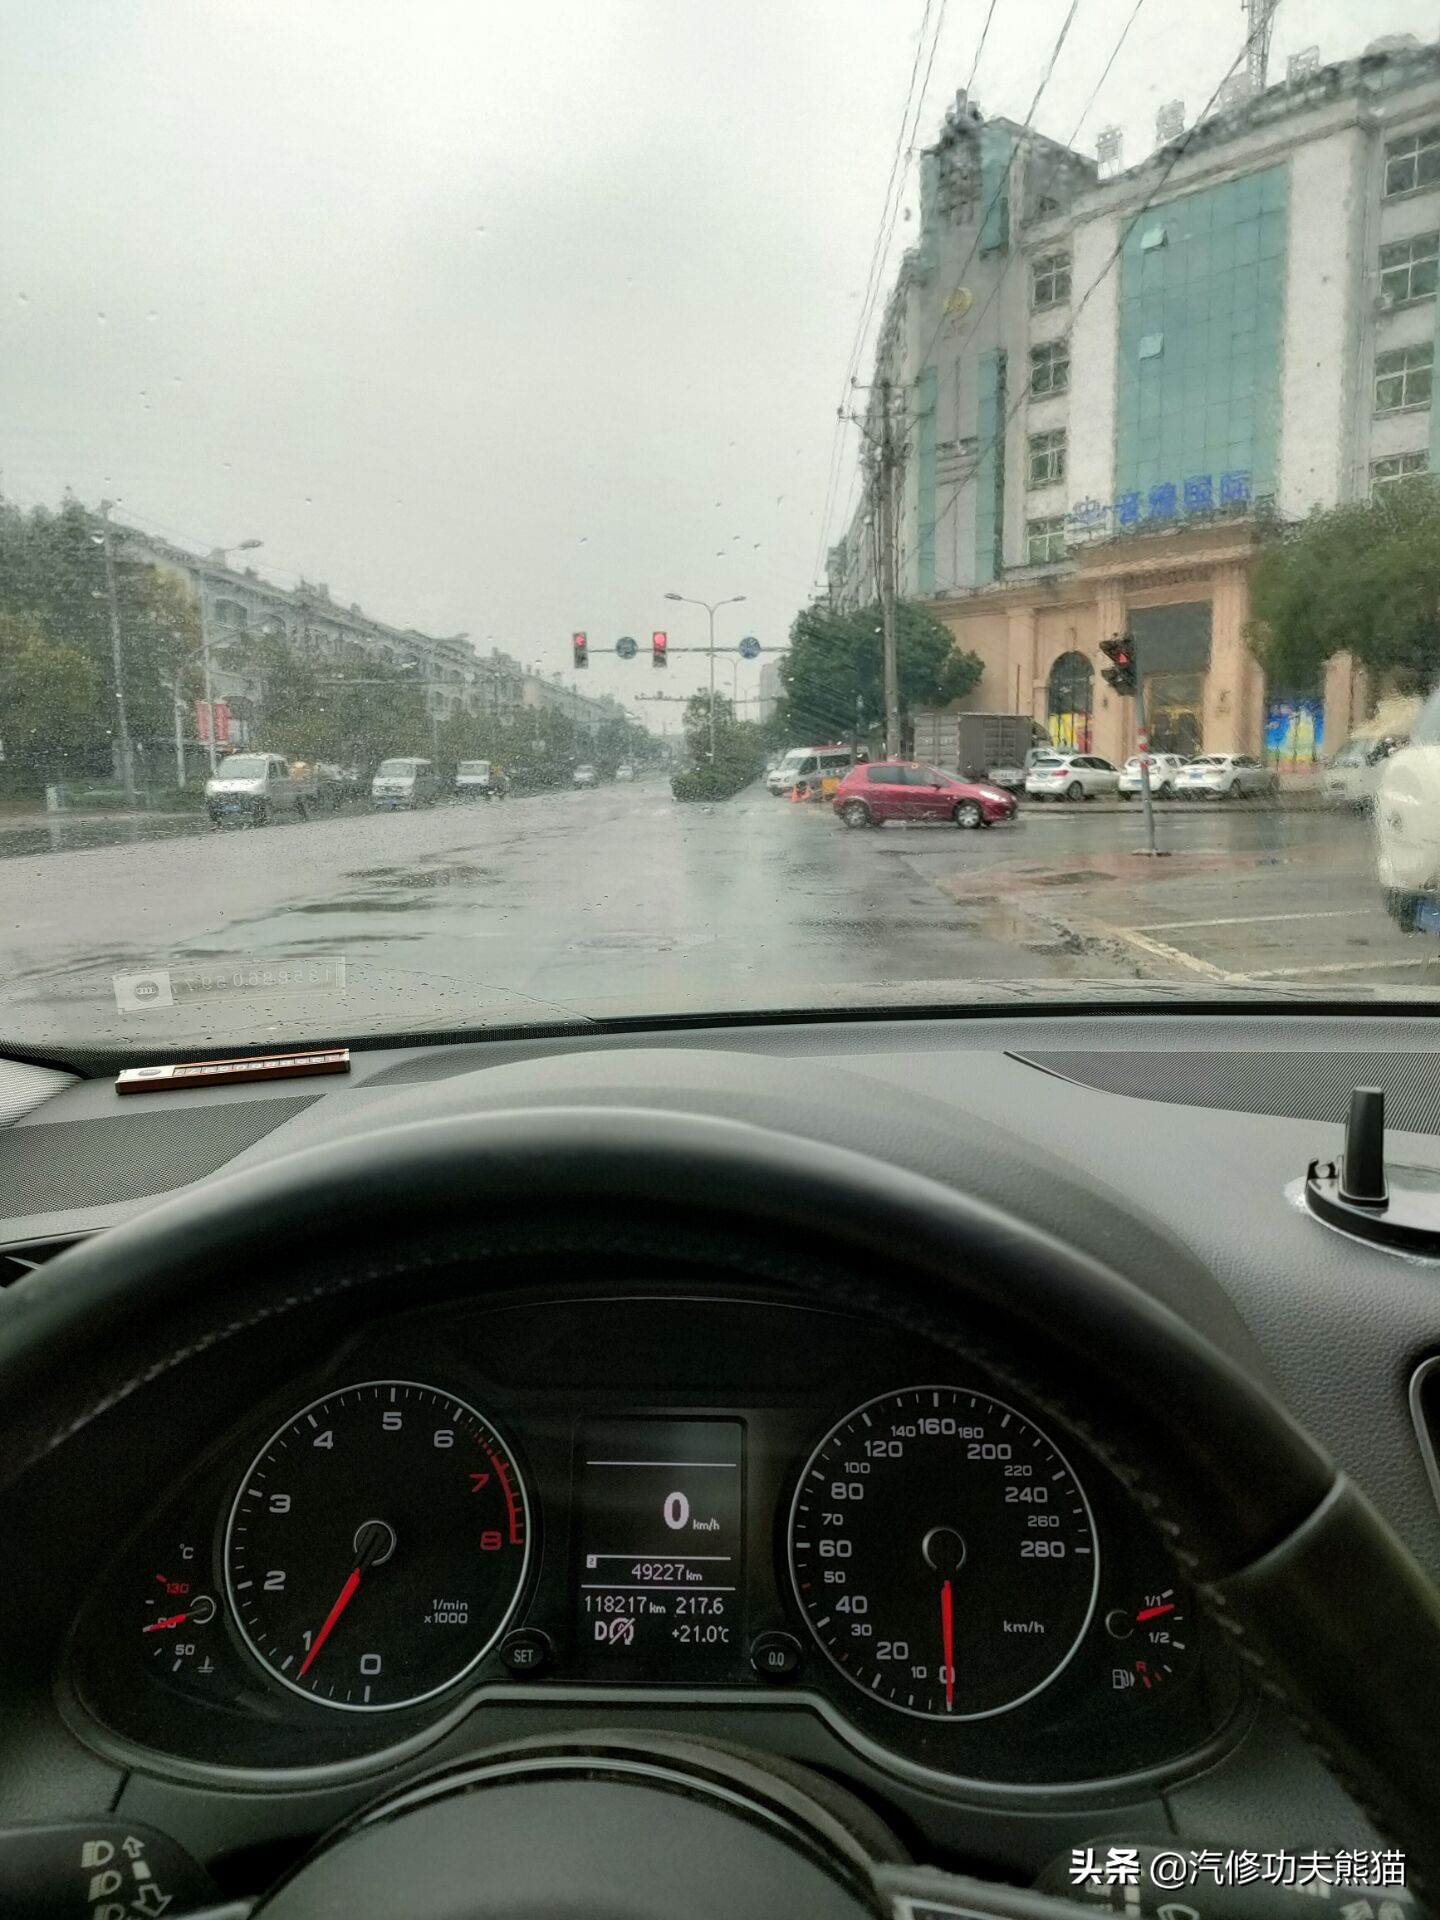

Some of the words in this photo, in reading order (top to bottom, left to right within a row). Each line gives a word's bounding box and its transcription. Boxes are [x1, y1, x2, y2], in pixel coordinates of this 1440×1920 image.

[383, 1412, 402, 1430] 5
[918, 1419, 955, 1434] 160
[434, 1430, 453, 1447] 6
[891, 1426, 916, 1437] 140
[958, 1427, 983, 1438] 180
[314, 1431, 333, 1449] 4
[865, 1441, 902, 1457] 120
[968, 1444, 1011, 1459] 200
[844, 1462, 870, 1473] 100
[1005, 1465, 1032, 1476] 220
[470, 1474, 489, 1491] 7
[831, 1482, 863, 1499] 80
[1005, 1487, 1047, 1503] 240
[270, 1495, 290, 1513] 3
[664, 1492, 689, 1529] 0
[693, 1518, 719, 1531] km/h
[822, 1513, 843, 1525] 70
[1028, 1516, 1059, 1527] 260
[481, 1532, 501, 1550] 8
[820, 1540, 851, 1557] 60
[1021, 1541, 1065, 1557] 280
[632, 1564, 684, 1580] 49227
[824, 1571, 845, 1583] 50
[167, 1584, 188, 1593] 130
[264, 1571, 285, 1590] 2
[433, 1600, 467, 1610] 1/min
[585, 1596, 646, 1613] 118217
[676, 1597, 723, 1614] 217.6
[836, 1596, 867, 1613] 40
[1145, 1596, 1162, 1607] 1/1
[852, 1624, 872, 1636] 30
[1004, 1621, 1044, 1633] km/h
[303, 1631, 313, 1651] 1
[1149, 1632, 1169, 1643] 1/2
[175, 1644, 194, 1655] 50
[514, 1650, 533, 1662] SET
[877, 1642, 908, 1659] 20
[360, 1654, 381, 1674] 0
[912, 1666, 926, 1678] 10
